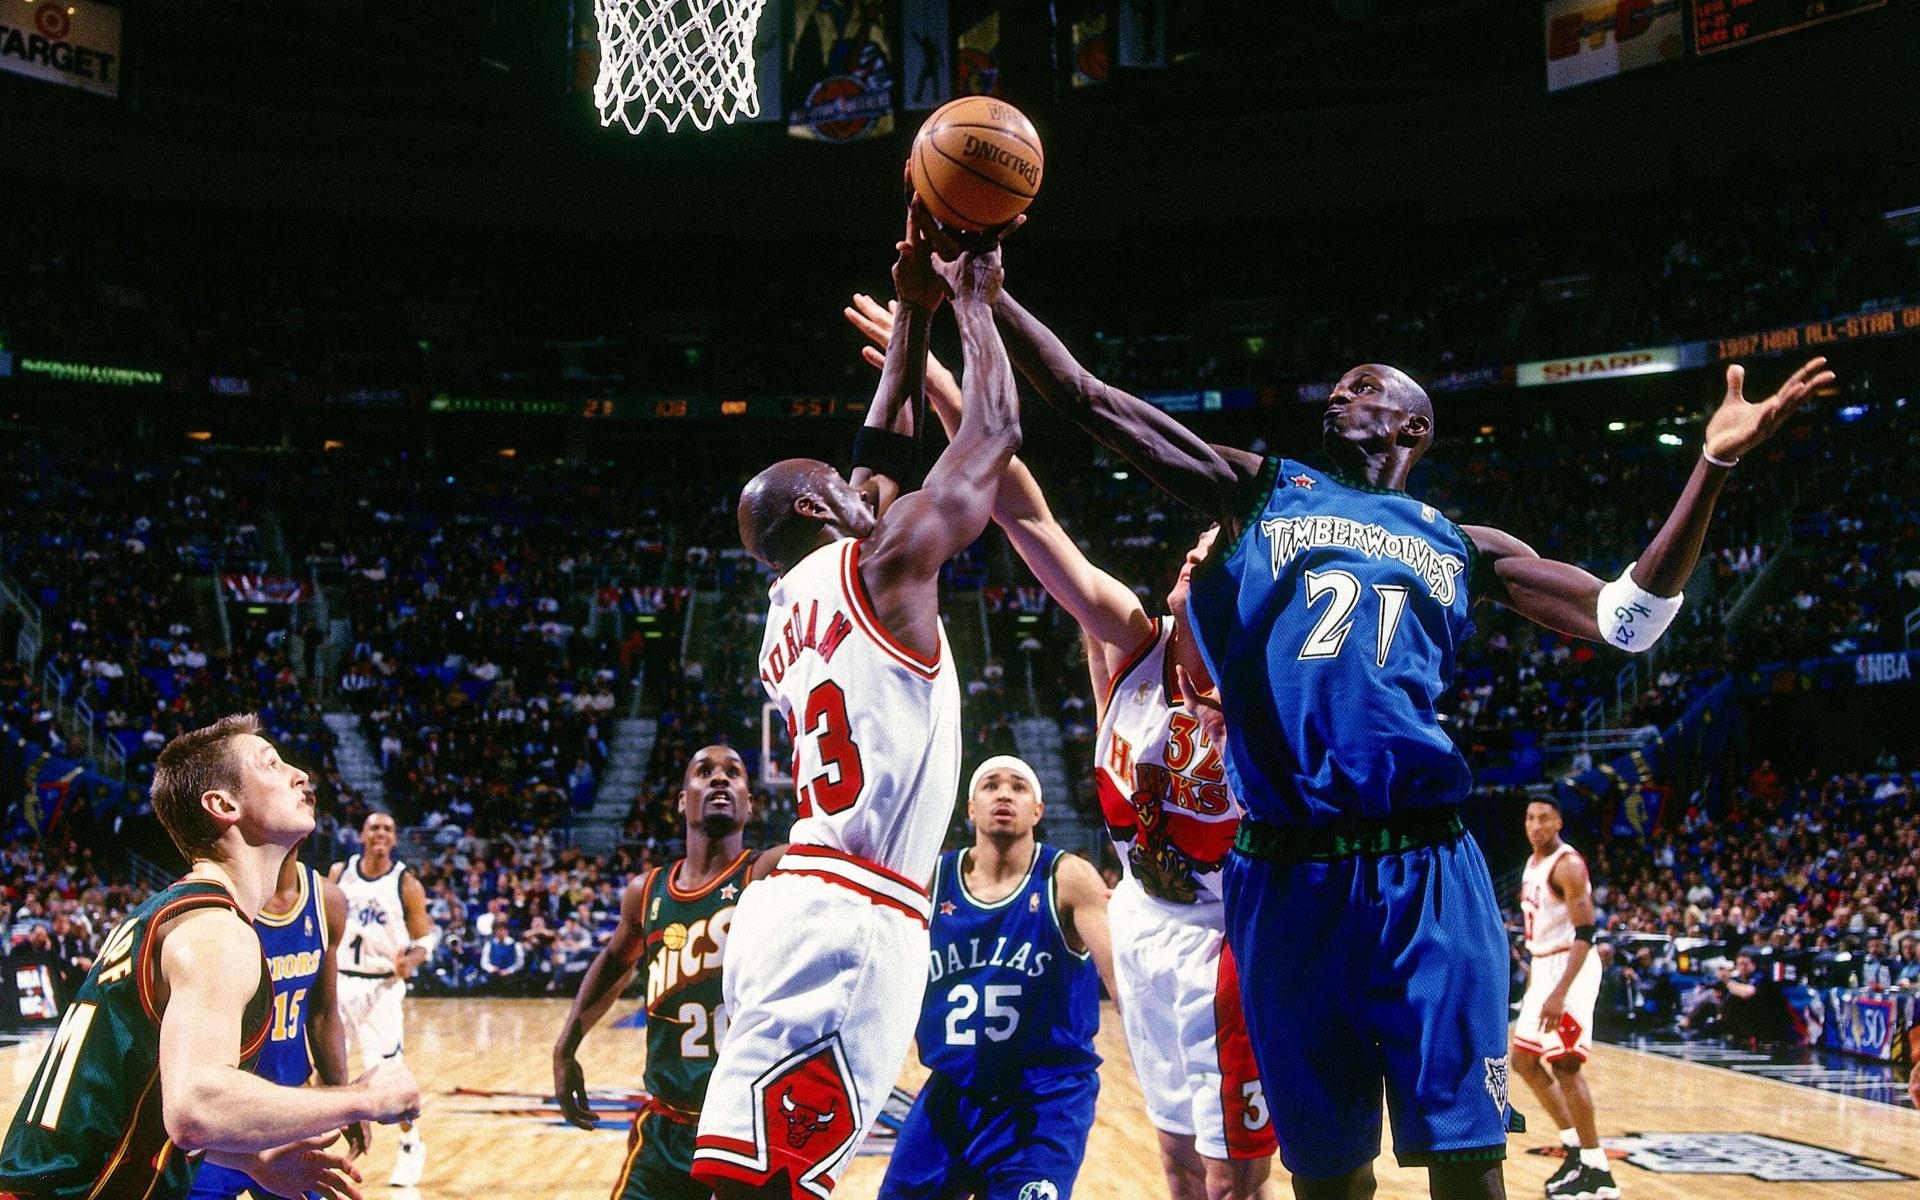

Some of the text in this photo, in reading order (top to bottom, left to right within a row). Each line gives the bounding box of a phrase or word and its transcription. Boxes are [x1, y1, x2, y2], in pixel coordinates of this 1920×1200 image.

[962, 133, 1040, 188] SPALDING
[1260, 514, 1465, 606] TIMBERWOLVES
[1297, 569, 1411, 669] 21
[1868, 651, 1912, 684] NBA
[1162, 711, 1226, 783] 32
[349, 933, 363, 965] 1
[929, 937, 1053, 983] DALLAS
[271, 988, 308, 1042] 15
[945, 983, 1023, 1046] 25
[1242, 1079, 1270, 1131] 3
